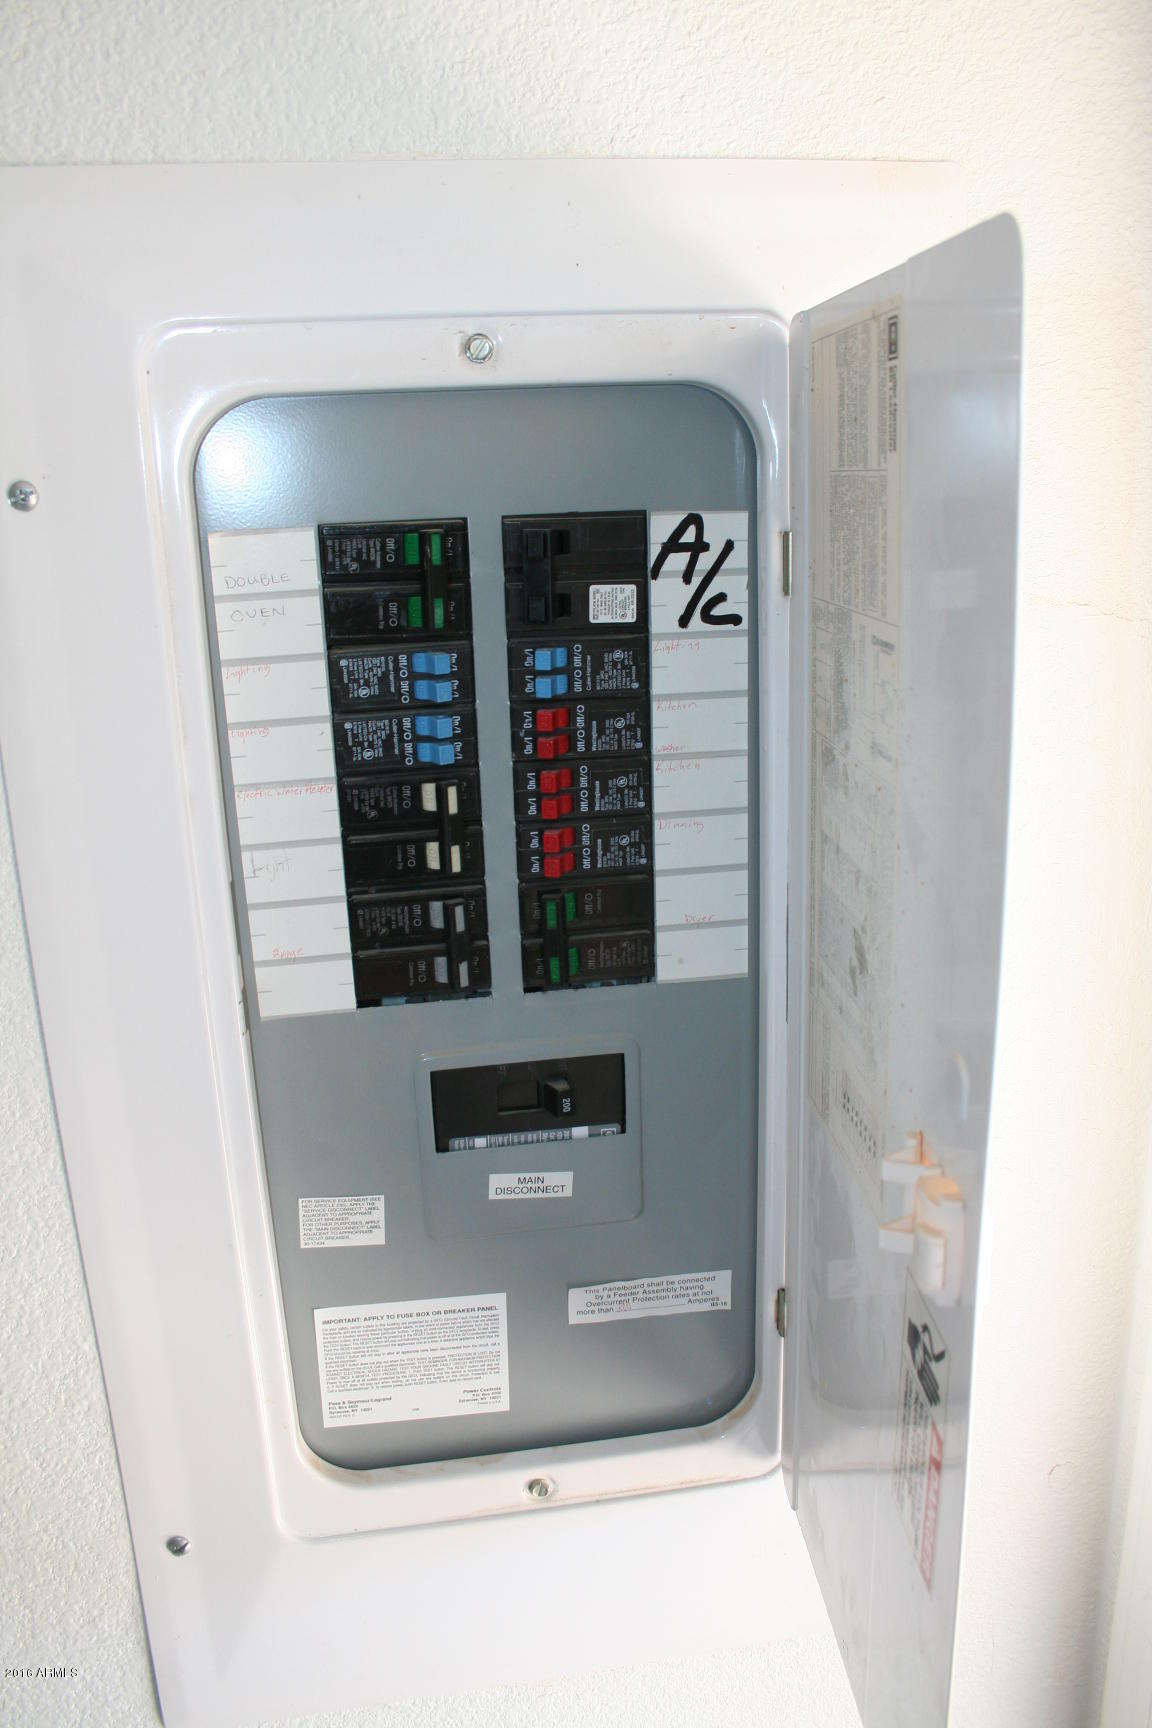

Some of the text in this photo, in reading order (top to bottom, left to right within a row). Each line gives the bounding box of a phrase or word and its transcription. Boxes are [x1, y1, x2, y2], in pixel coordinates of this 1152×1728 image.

[224, 573, 290, 589] DOUBLE
[562, 1097, 571, 1113] 200
[517, 1175, 545, 1185] MAIN
[495, 1184, 566, 1196] DISCONNECT
[602, 1283, 645, 1292] Panelboard
[677, 1276, 716, 1284] connected
[614, 1290, 639, 1298] Feeder
[642, 1287, 677, 1296] Assembly
[680, 1284, 704, 1293] having
[586, 1298, 630, 1308] Overcurrent
[633, 1294, 669, 1303] Protection
[702, 1289, 712, 1297] not
[688, 1296, 720, 1305] Amperes
[577, 1308, 595, 1316] more
